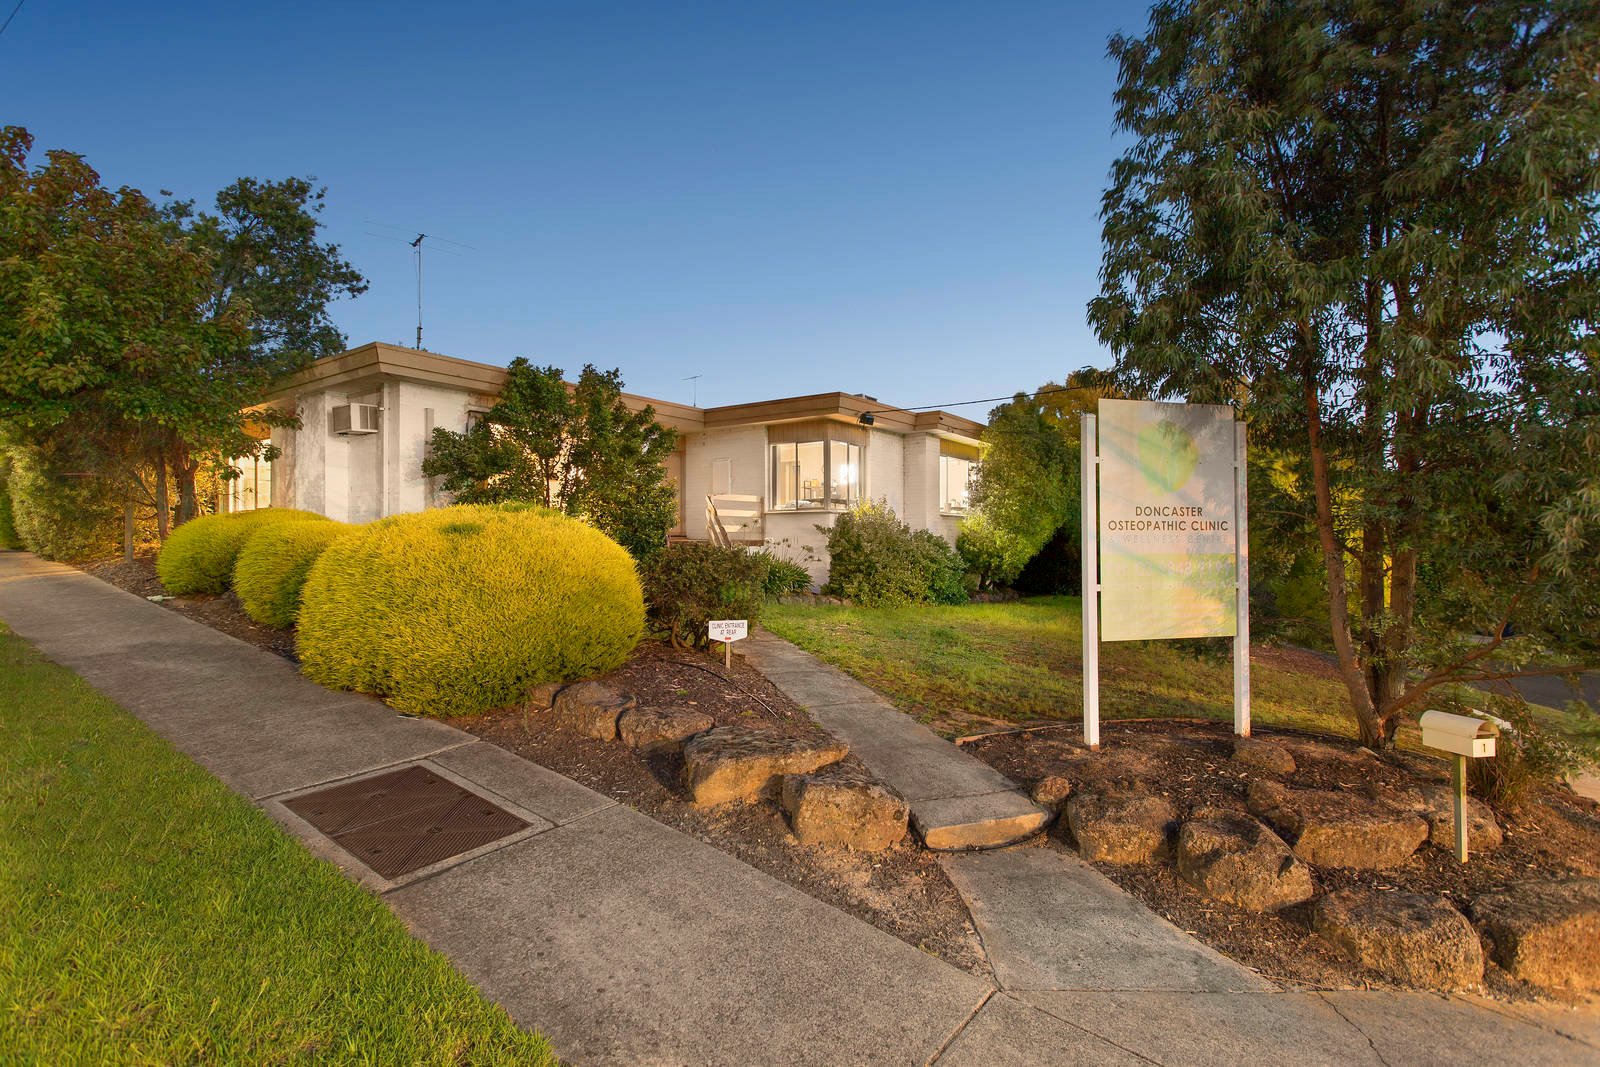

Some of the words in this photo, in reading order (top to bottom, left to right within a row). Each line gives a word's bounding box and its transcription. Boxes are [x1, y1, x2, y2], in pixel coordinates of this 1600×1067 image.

[1135, 506, 1203, 517] DONCASTER
[1108, 520, 1187, 531] OSTEOPATHIC
[1191, 520, 1229, 531] CLINIC
